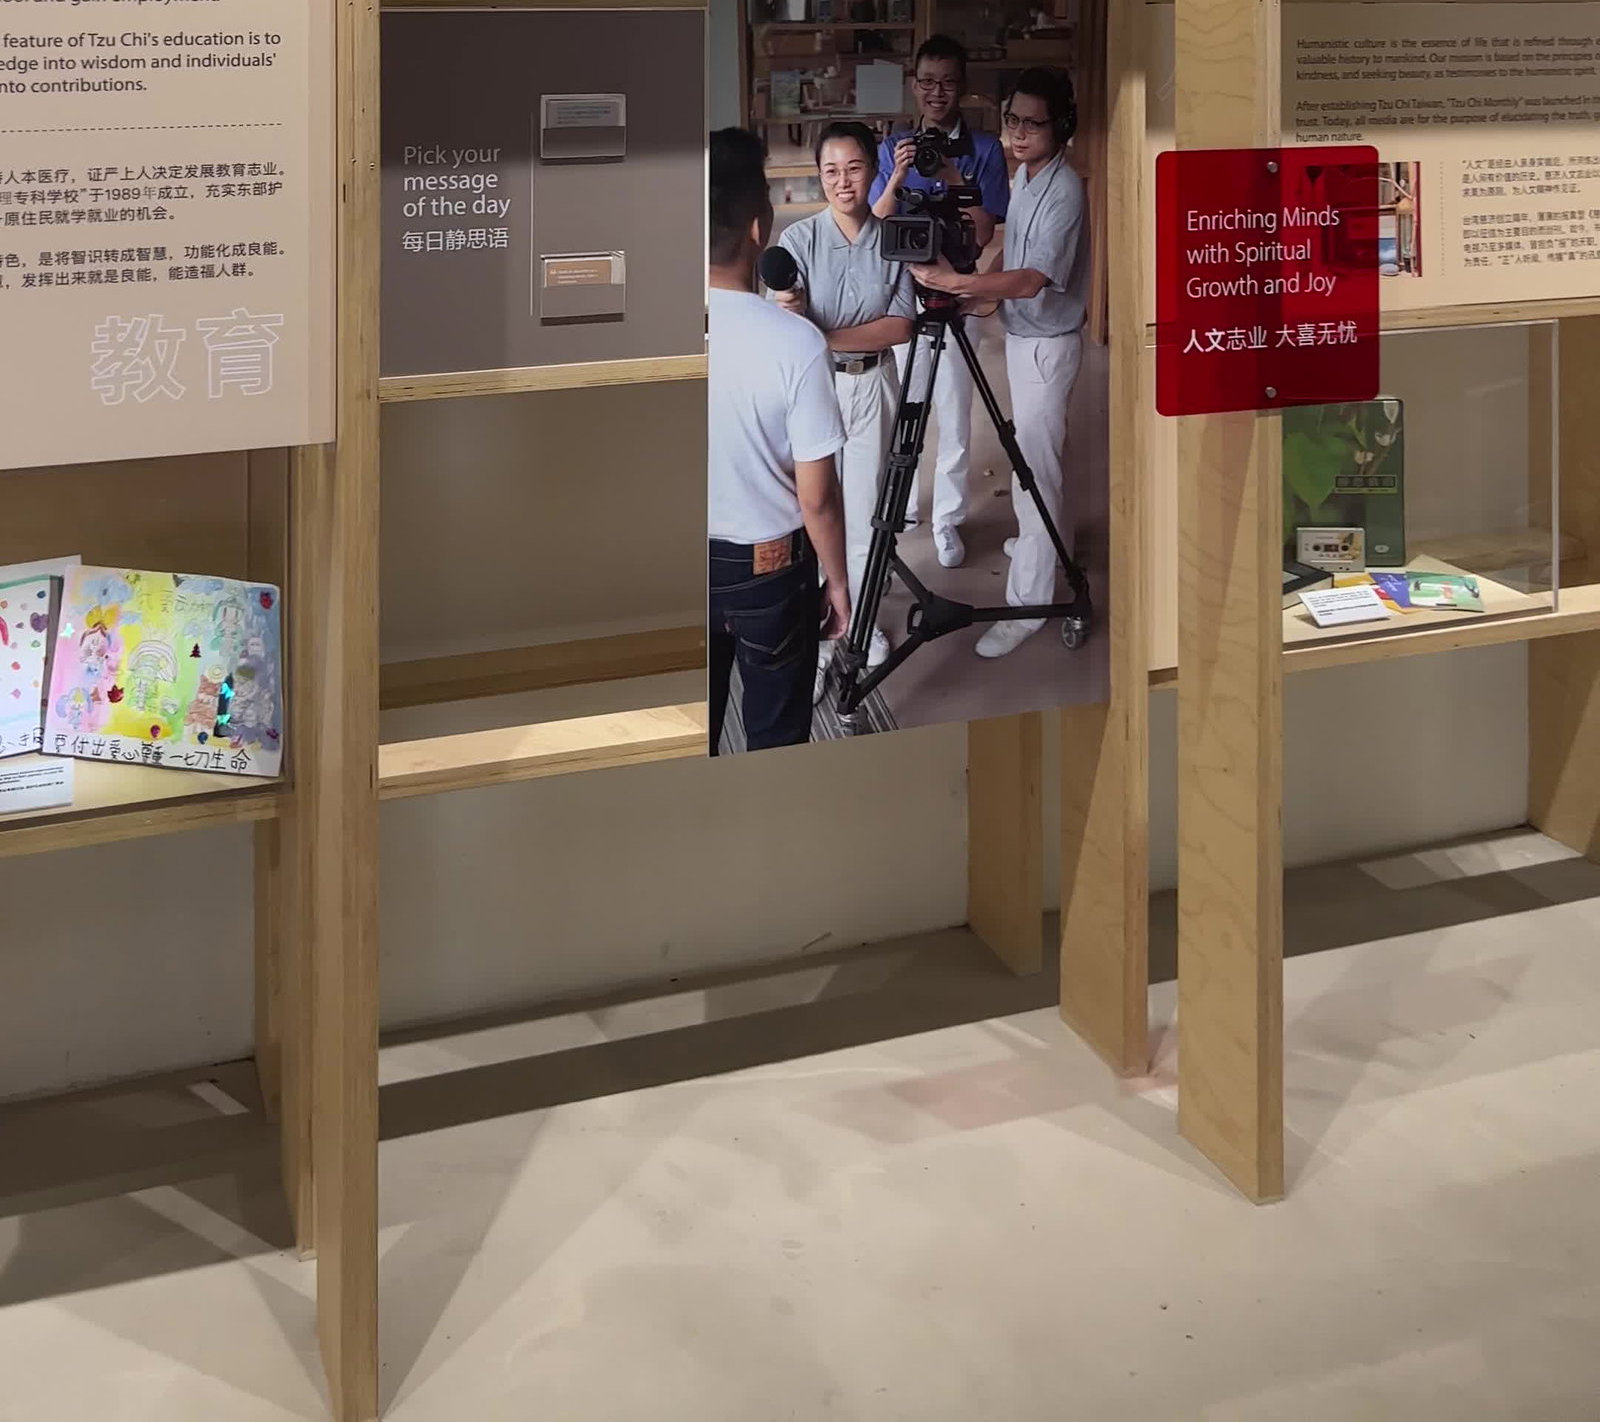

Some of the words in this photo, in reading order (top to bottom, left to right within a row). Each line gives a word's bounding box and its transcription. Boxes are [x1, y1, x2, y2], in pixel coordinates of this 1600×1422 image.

[3, 33, 63, 48] feature
[67, 32, 87, 48] of
[87, 33, 116, 48] Tzu
[120, 32, 159, 47] Chi's
[163, 31, 244, 47] education
[248, 31, 261, 45] is
[265, 33, 281, 45] to
[43, 55, 77, 70] into
[81, 55, 146, 70] wisdom
[151, 54, 182, 69] and
[186, 53, 277, 68] individuals'
[31, 77, 147, 94] contributions.
[1432, 113, 1448, 124] the
[1296, 132, 1329, 143] human
[1331, 132, 1364, 142] nature.
[403, 145, 447, 165] Pick
[452, 146, 502, 168] your
[403, 173, 498, 194] message
[403, 196, 426, 217] of
[430, 196, 466, 216] the
[472, 194, 511, 218] day
[1187, 208, 1277, 233] Enriching
[1282, 205, 1340, 227] Minds
[402, 227, 510, 252] 每日静思语
[1186, 242, 1229, 264] with
[1234, 238, 1311, 266] Spiritual
[1186, 274, 1258, 298] Growth
[1263, 272, 1300, 295] and
[1304, 275, 1336, 296] Joy
[1183, 326, 1268, 354] 人文志业
[1275, 321, 1358, 349] 大喜无忧
[90, 307, 284, 405] 教育
